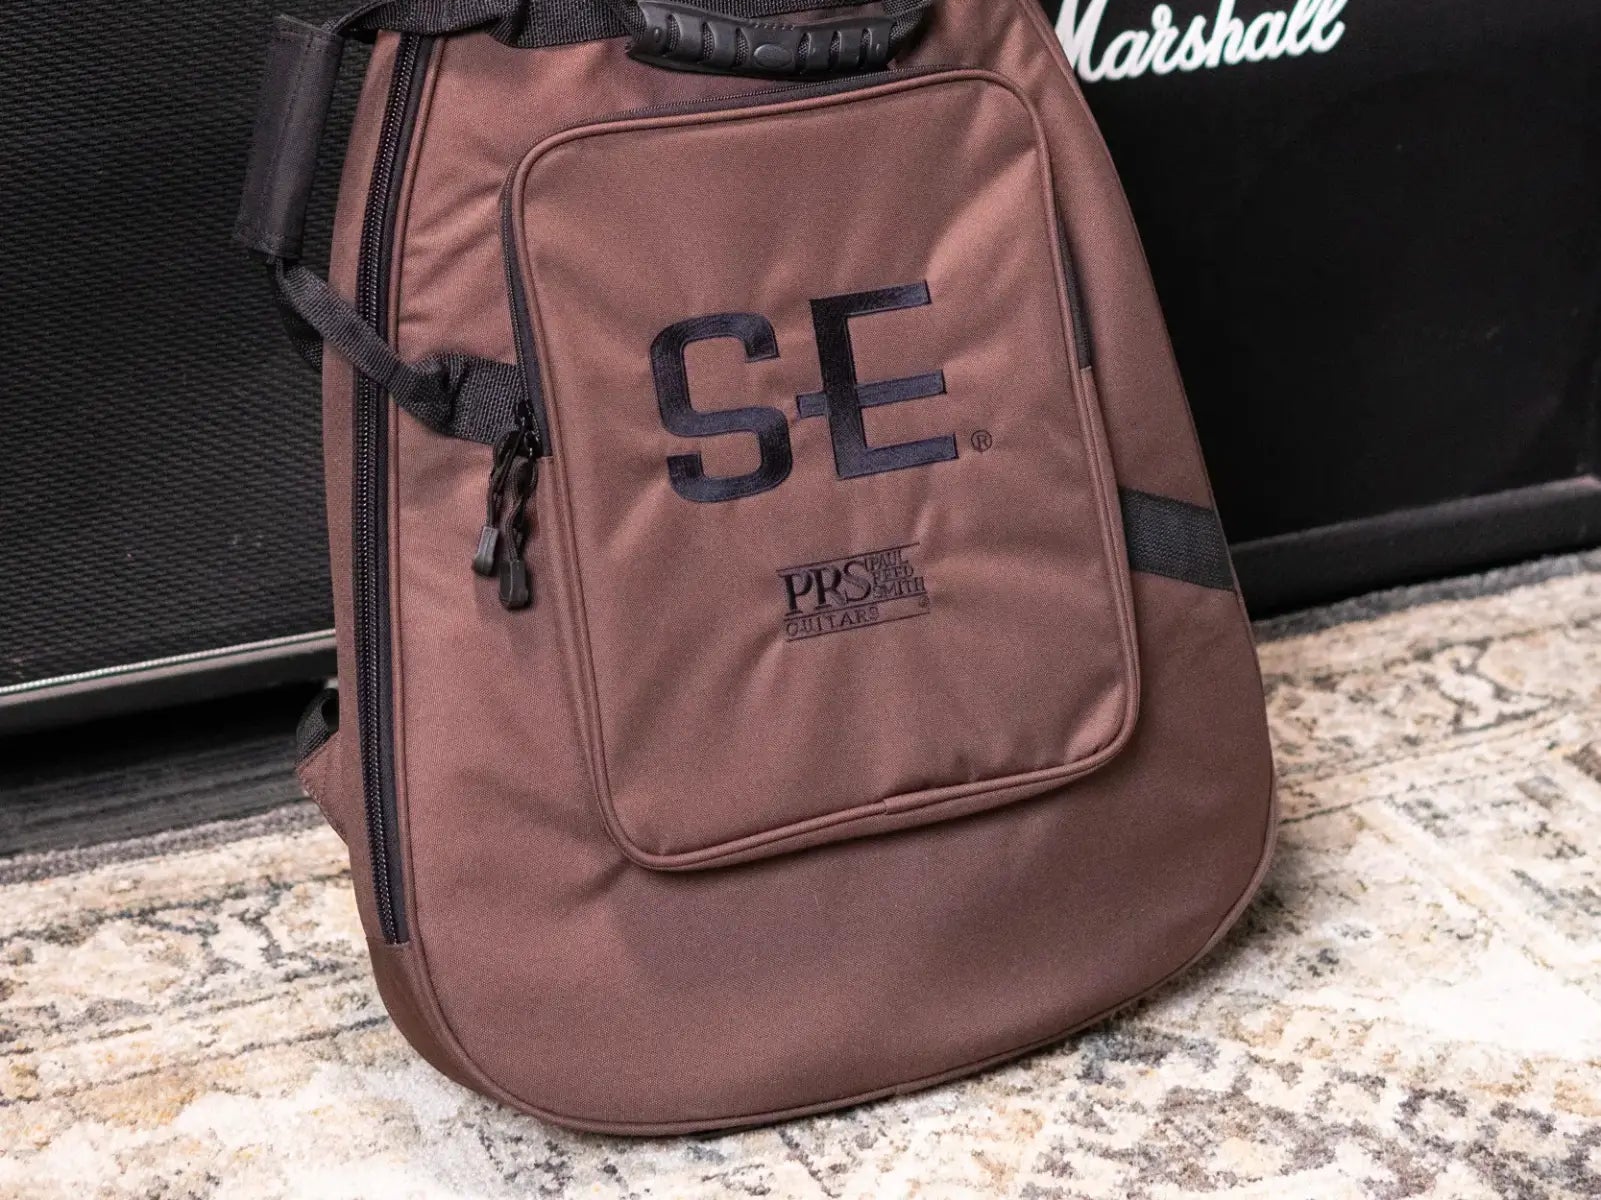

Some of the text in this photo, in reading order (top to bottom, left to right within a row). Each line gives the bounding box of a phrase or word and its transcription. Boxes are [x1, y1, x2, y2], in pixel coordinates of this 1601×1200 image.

[650, 279, 960, 503] SE
[870, 550, 906, 571] PAUL
[871, 562, 915, 586] REED
[778, 557, 872, 616] PRS
[872, 576, 926, 599] SMITH
[786, 606, 880, 637] GUITARS
